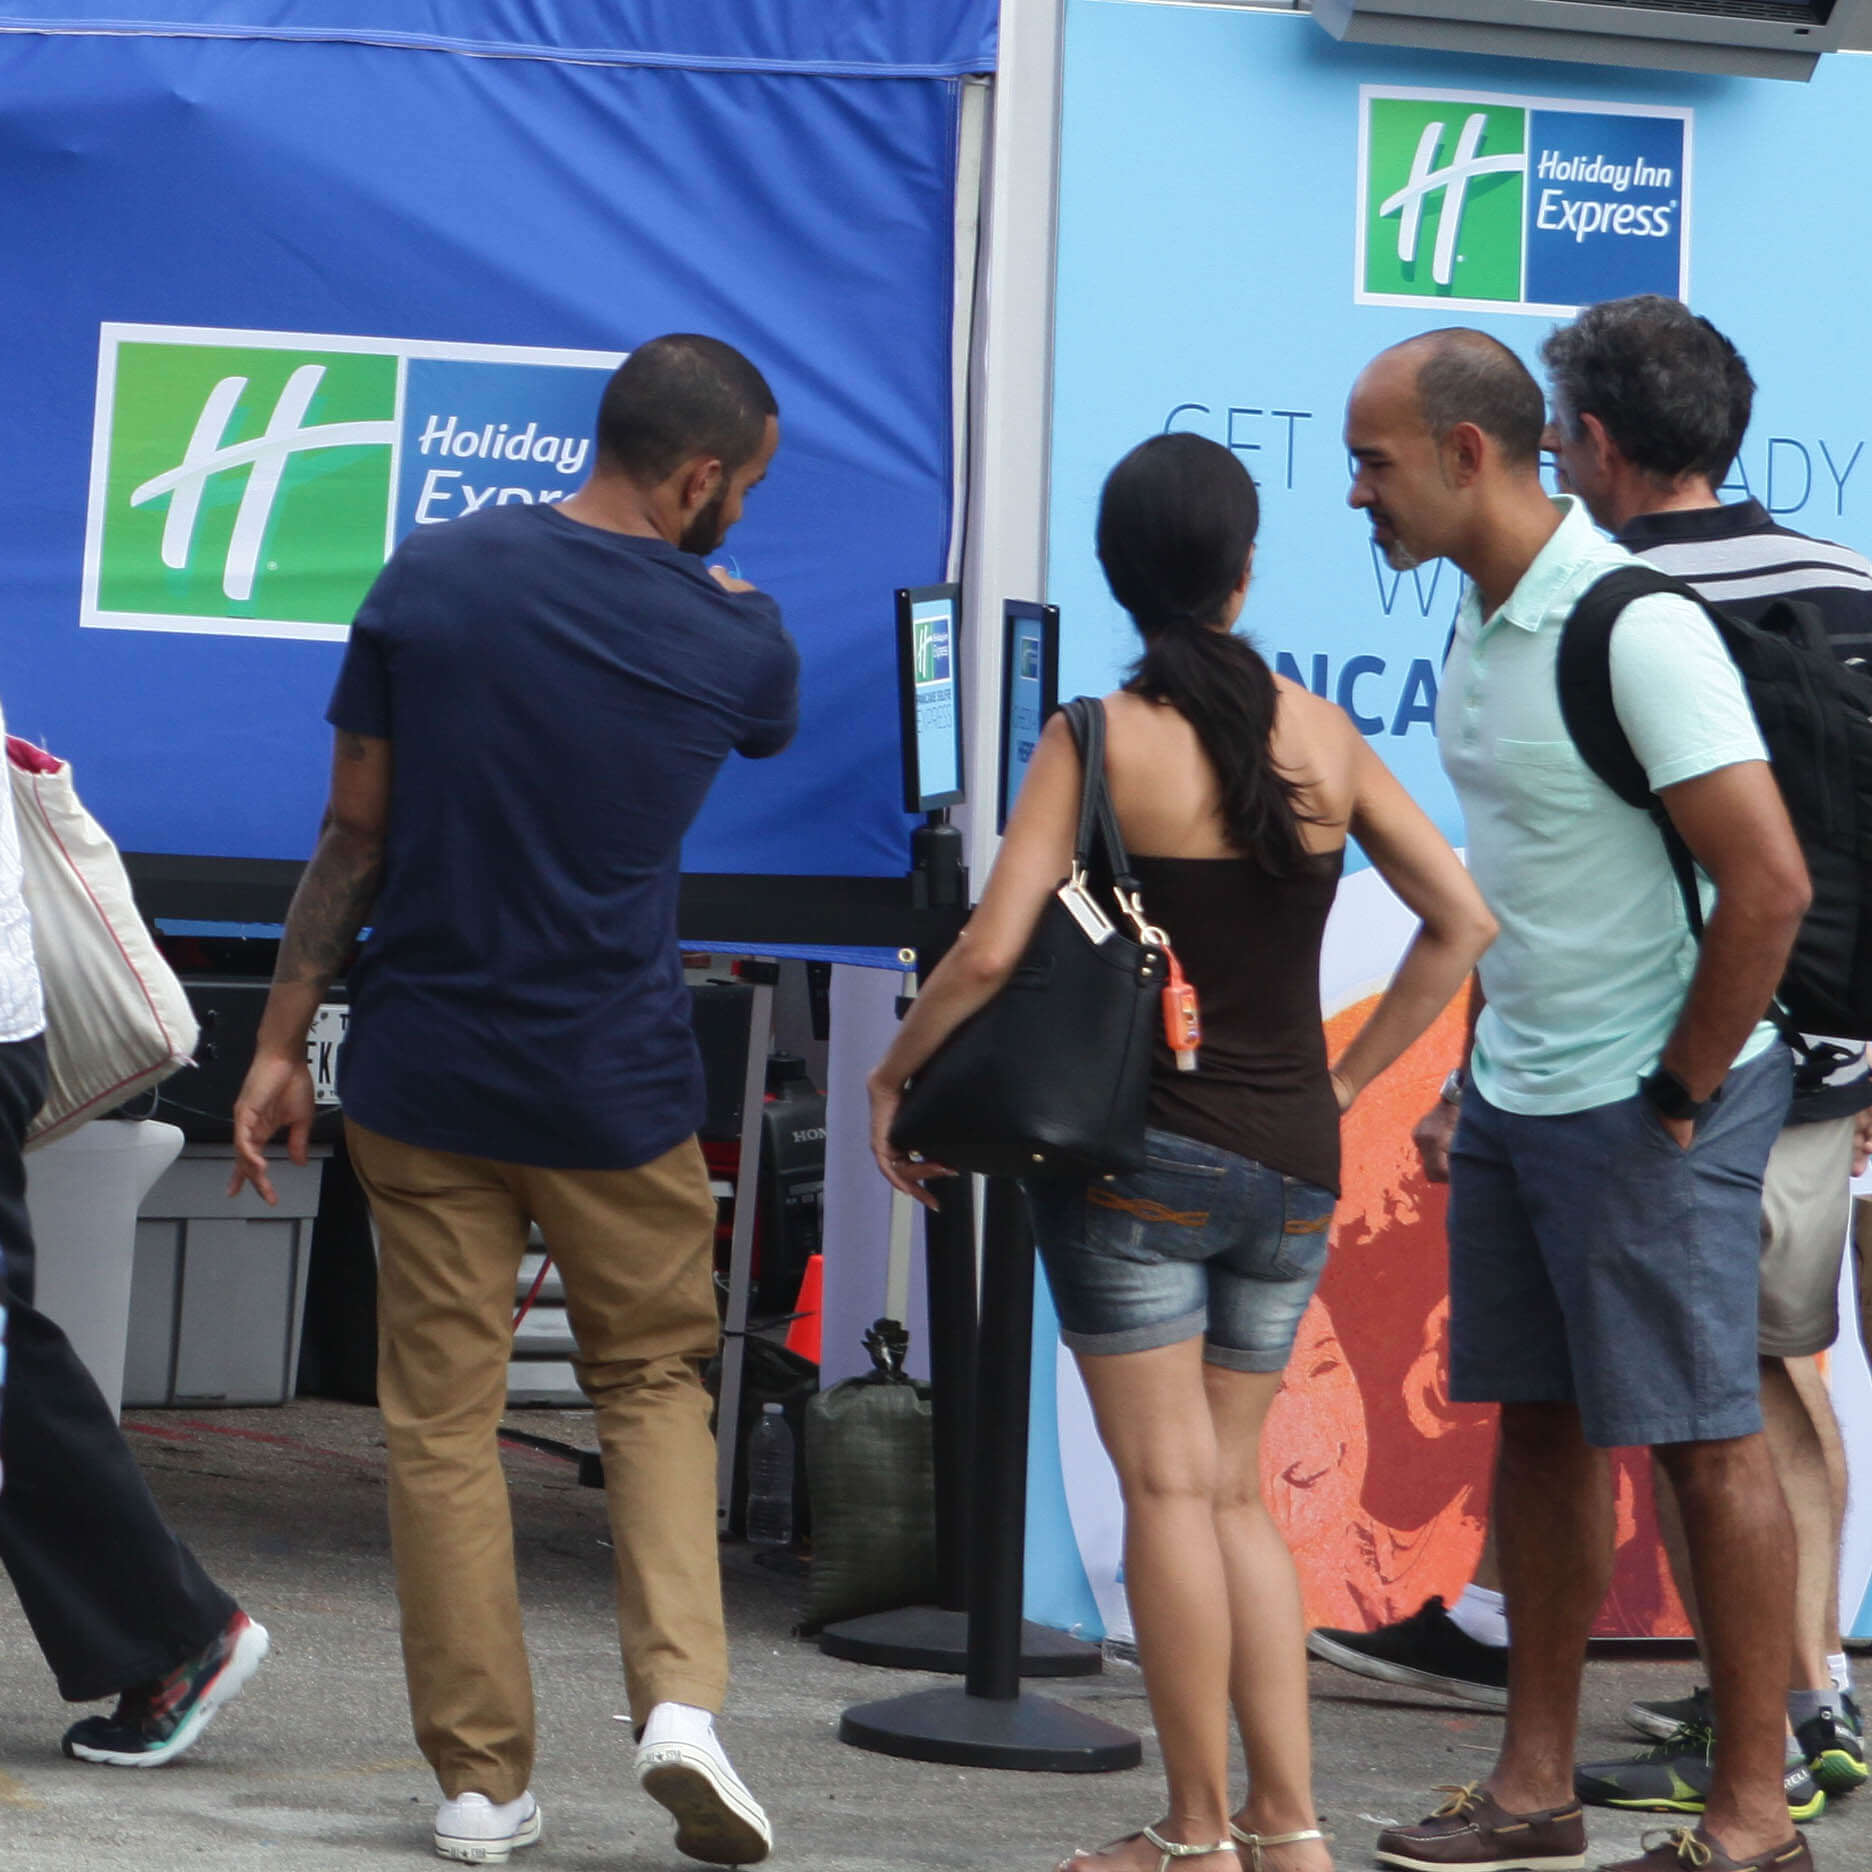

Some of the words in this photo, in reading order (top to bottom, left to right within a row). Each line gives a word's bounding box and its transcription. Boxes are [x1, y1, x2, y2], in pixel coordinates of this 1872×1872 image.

[1537, 149, 1633, 192] Holiday
[1633, 157, 1673, 189] Inn
[1535, 188, 1672, 244] Express
[418, 414, 591, 474] Holiday
[792, 1127, 826, 1144] HON
